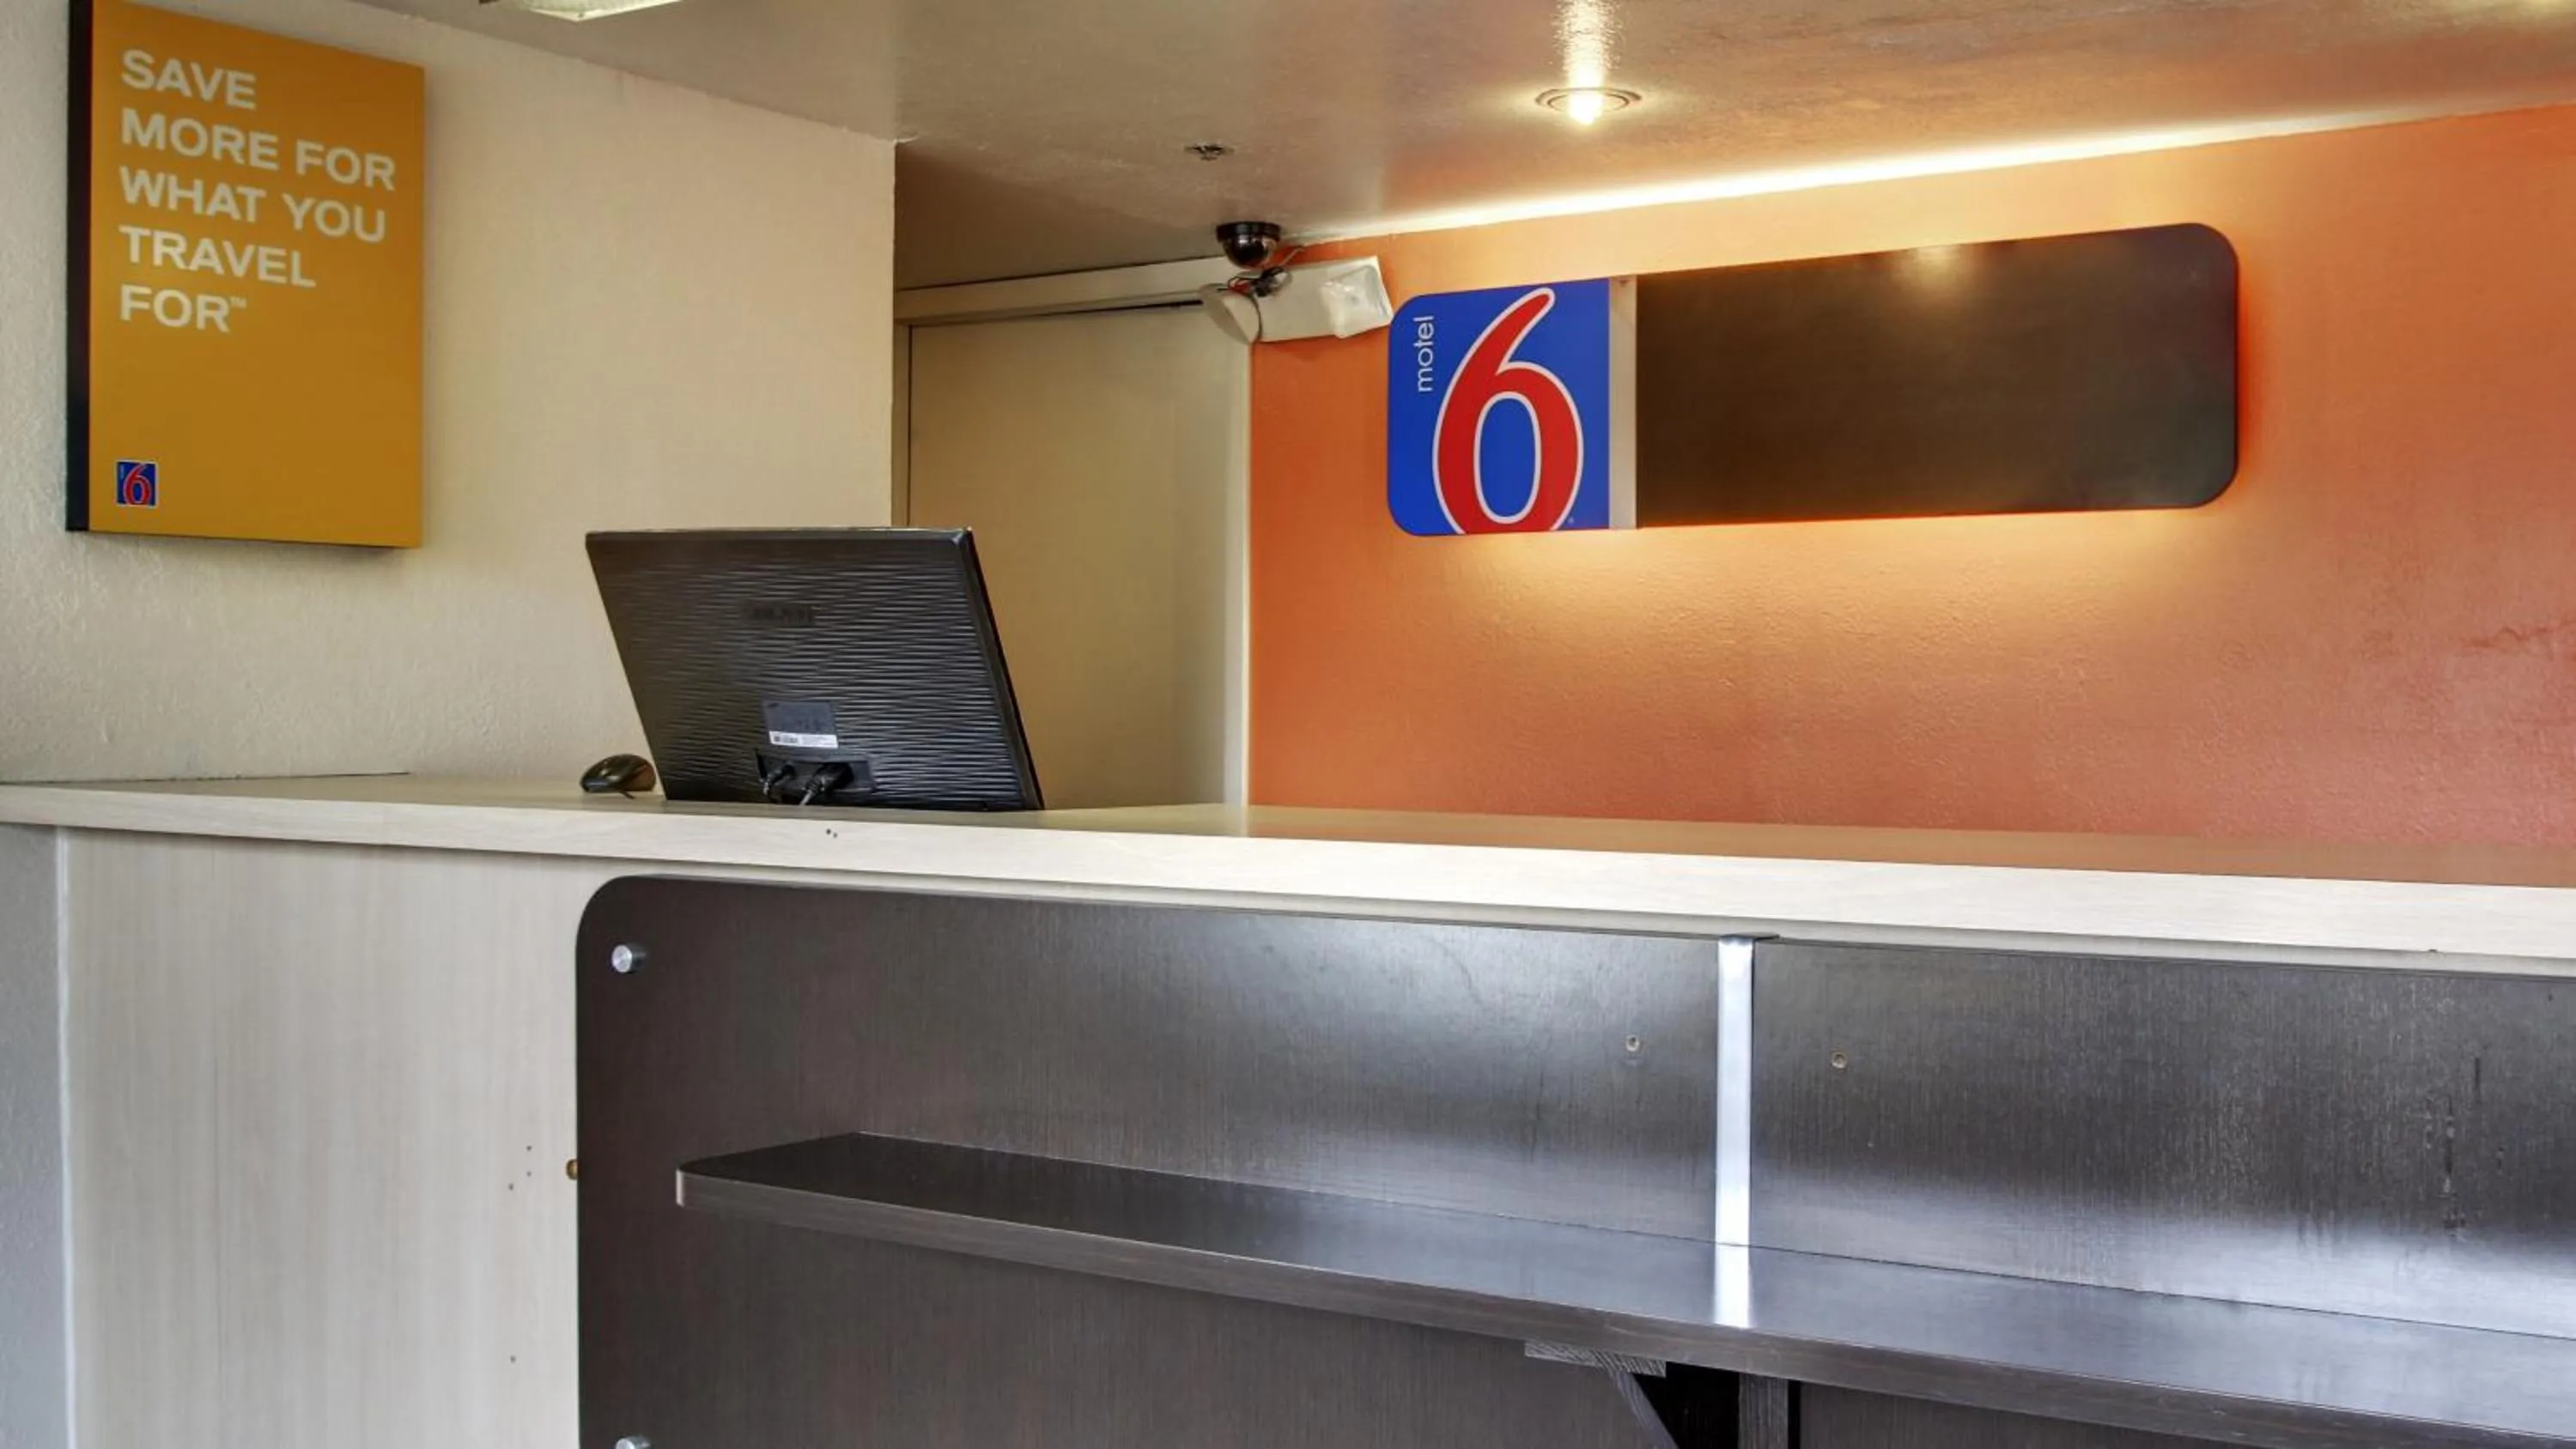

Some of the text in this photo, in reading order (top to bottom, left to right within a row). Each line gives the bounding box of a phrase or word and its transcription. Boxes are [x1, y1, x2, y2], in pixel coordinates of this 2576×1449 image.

[121, 49, 257, 111] SAVE
[121, 107, 397, 192] MORE FOR
[118, 166, 386, 244] WHAT YOU
[118, 225, 317, 288] TRAVEL
[1413, 314, 1435, 393] motel
[1431, 286, 1584, 536] 6
